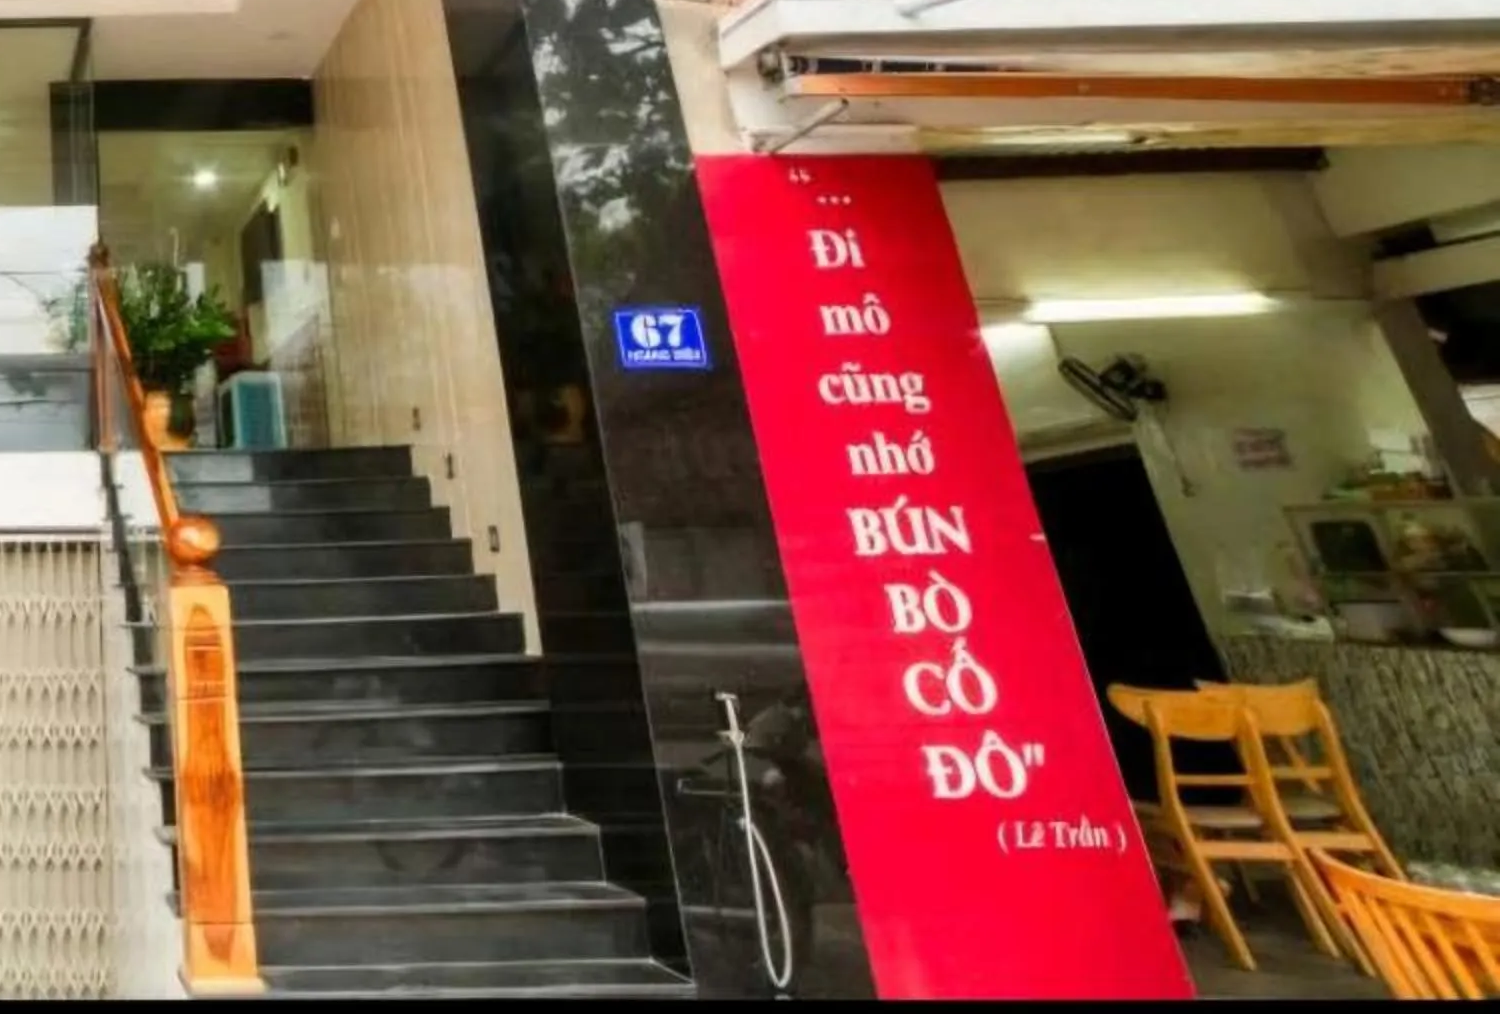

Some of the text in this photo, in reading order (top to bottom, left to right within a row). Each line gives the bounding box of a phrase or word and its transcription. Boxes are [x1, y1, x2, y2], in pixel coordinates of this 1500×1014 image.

[807, 227, 867, 269] Đi
[631, 314, 685, 349] 67
[819, 293, 891, 336] mô
[818, 361, 931, 414] cũng
[846, 431, 935, 475] nhớ
[847, 495, 972, 556] BÚN
[884, 569, 973, 634] BÒ
[902, 637, 999, 716] CỐ
